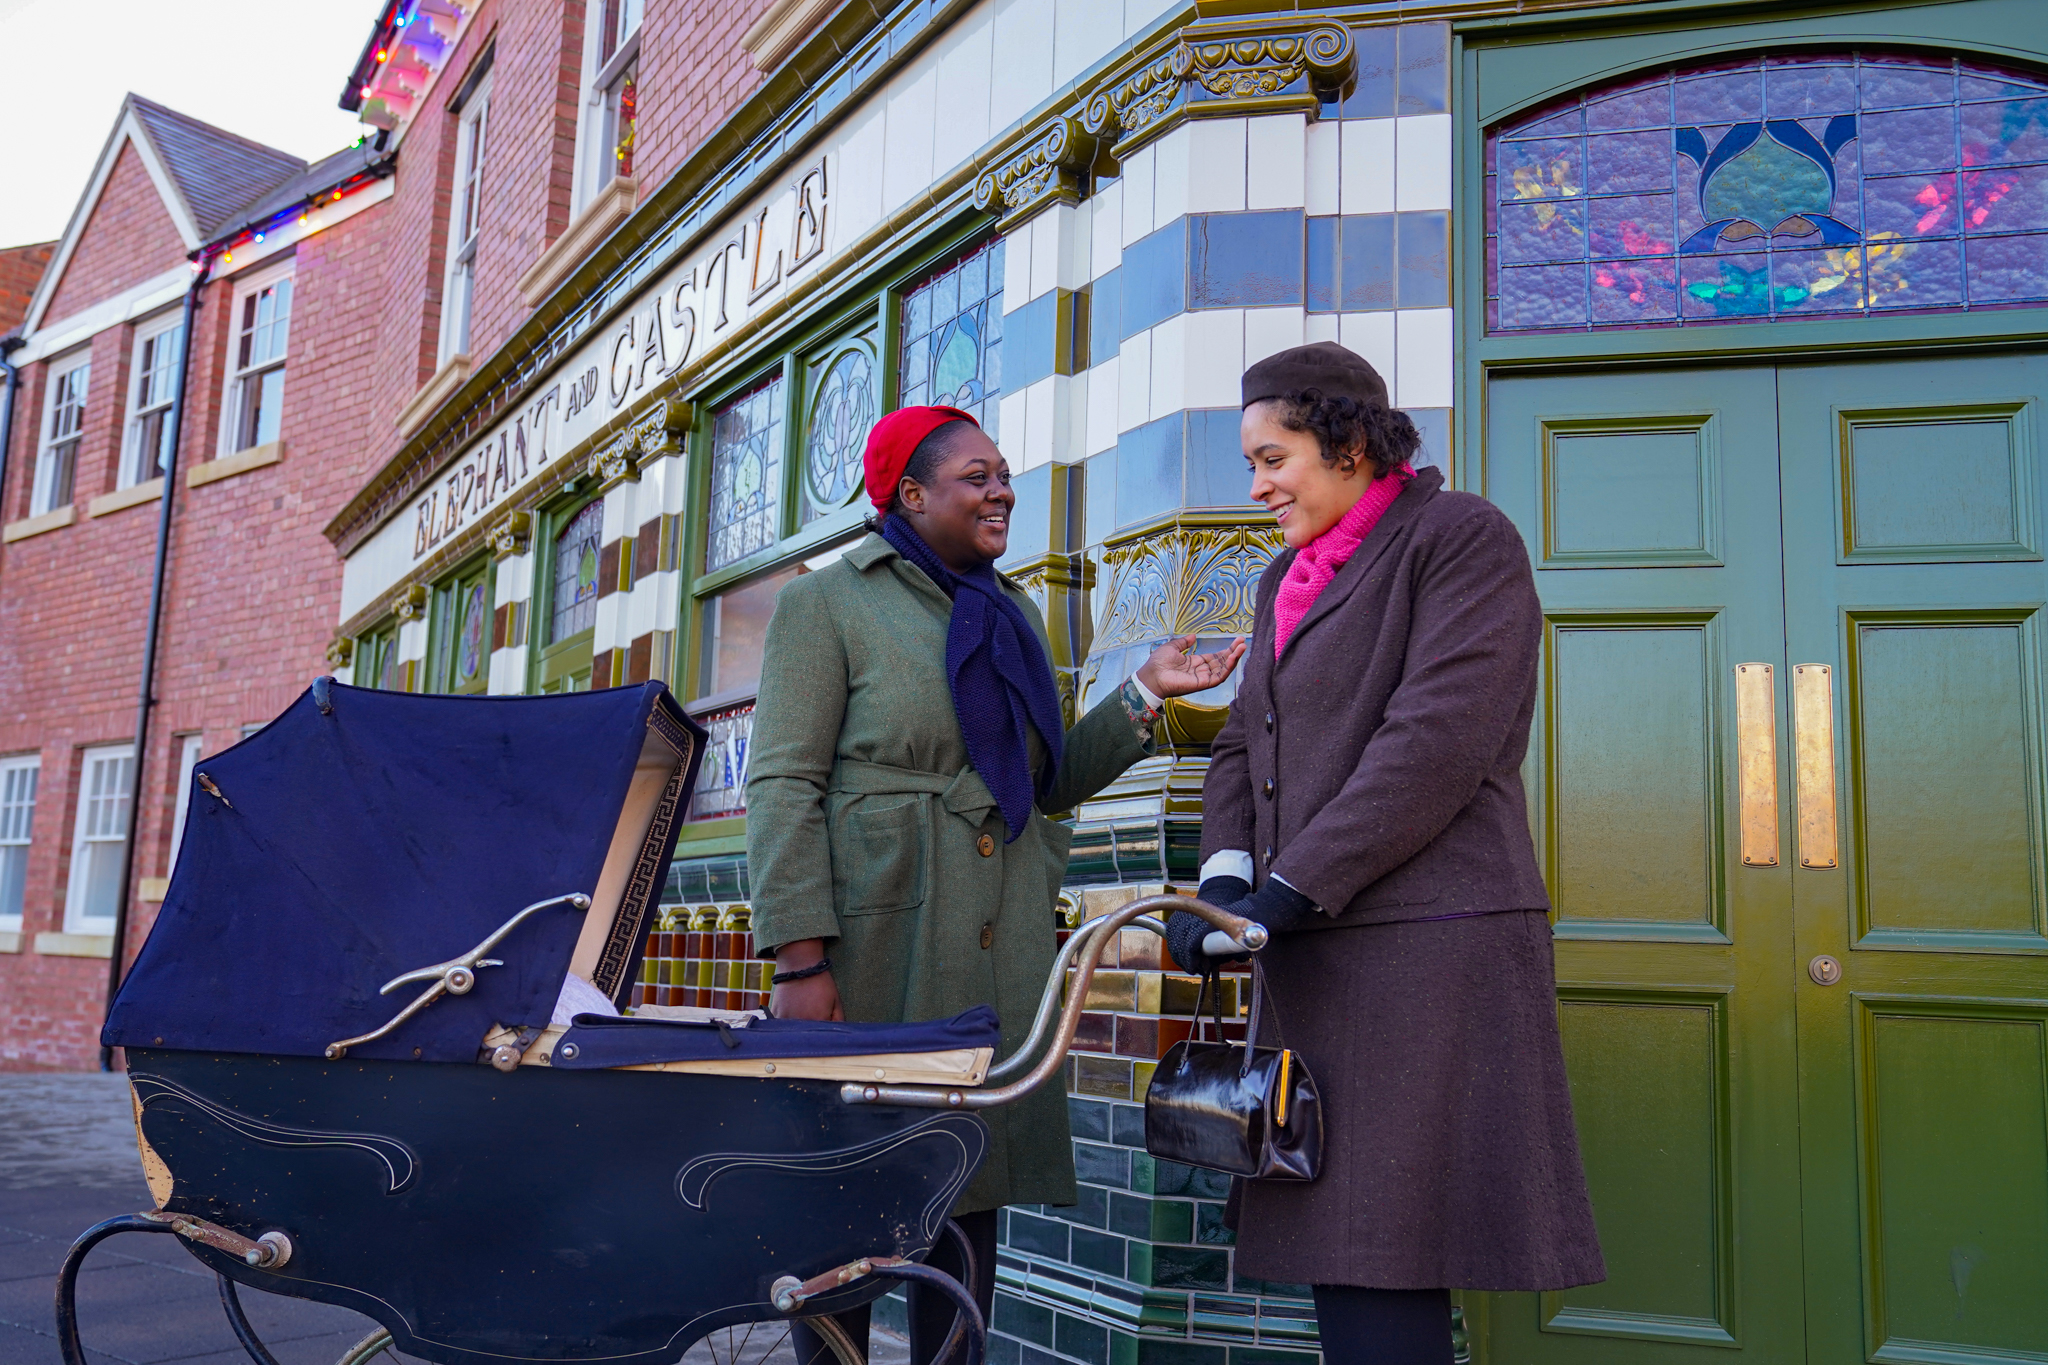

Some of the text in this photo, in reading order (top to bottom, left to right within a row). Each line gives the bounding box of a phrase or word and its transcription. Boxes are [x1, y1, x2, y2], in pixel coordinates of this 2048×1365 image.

[413, 155, 828, 560] ELEPHANT AND CASTLE
